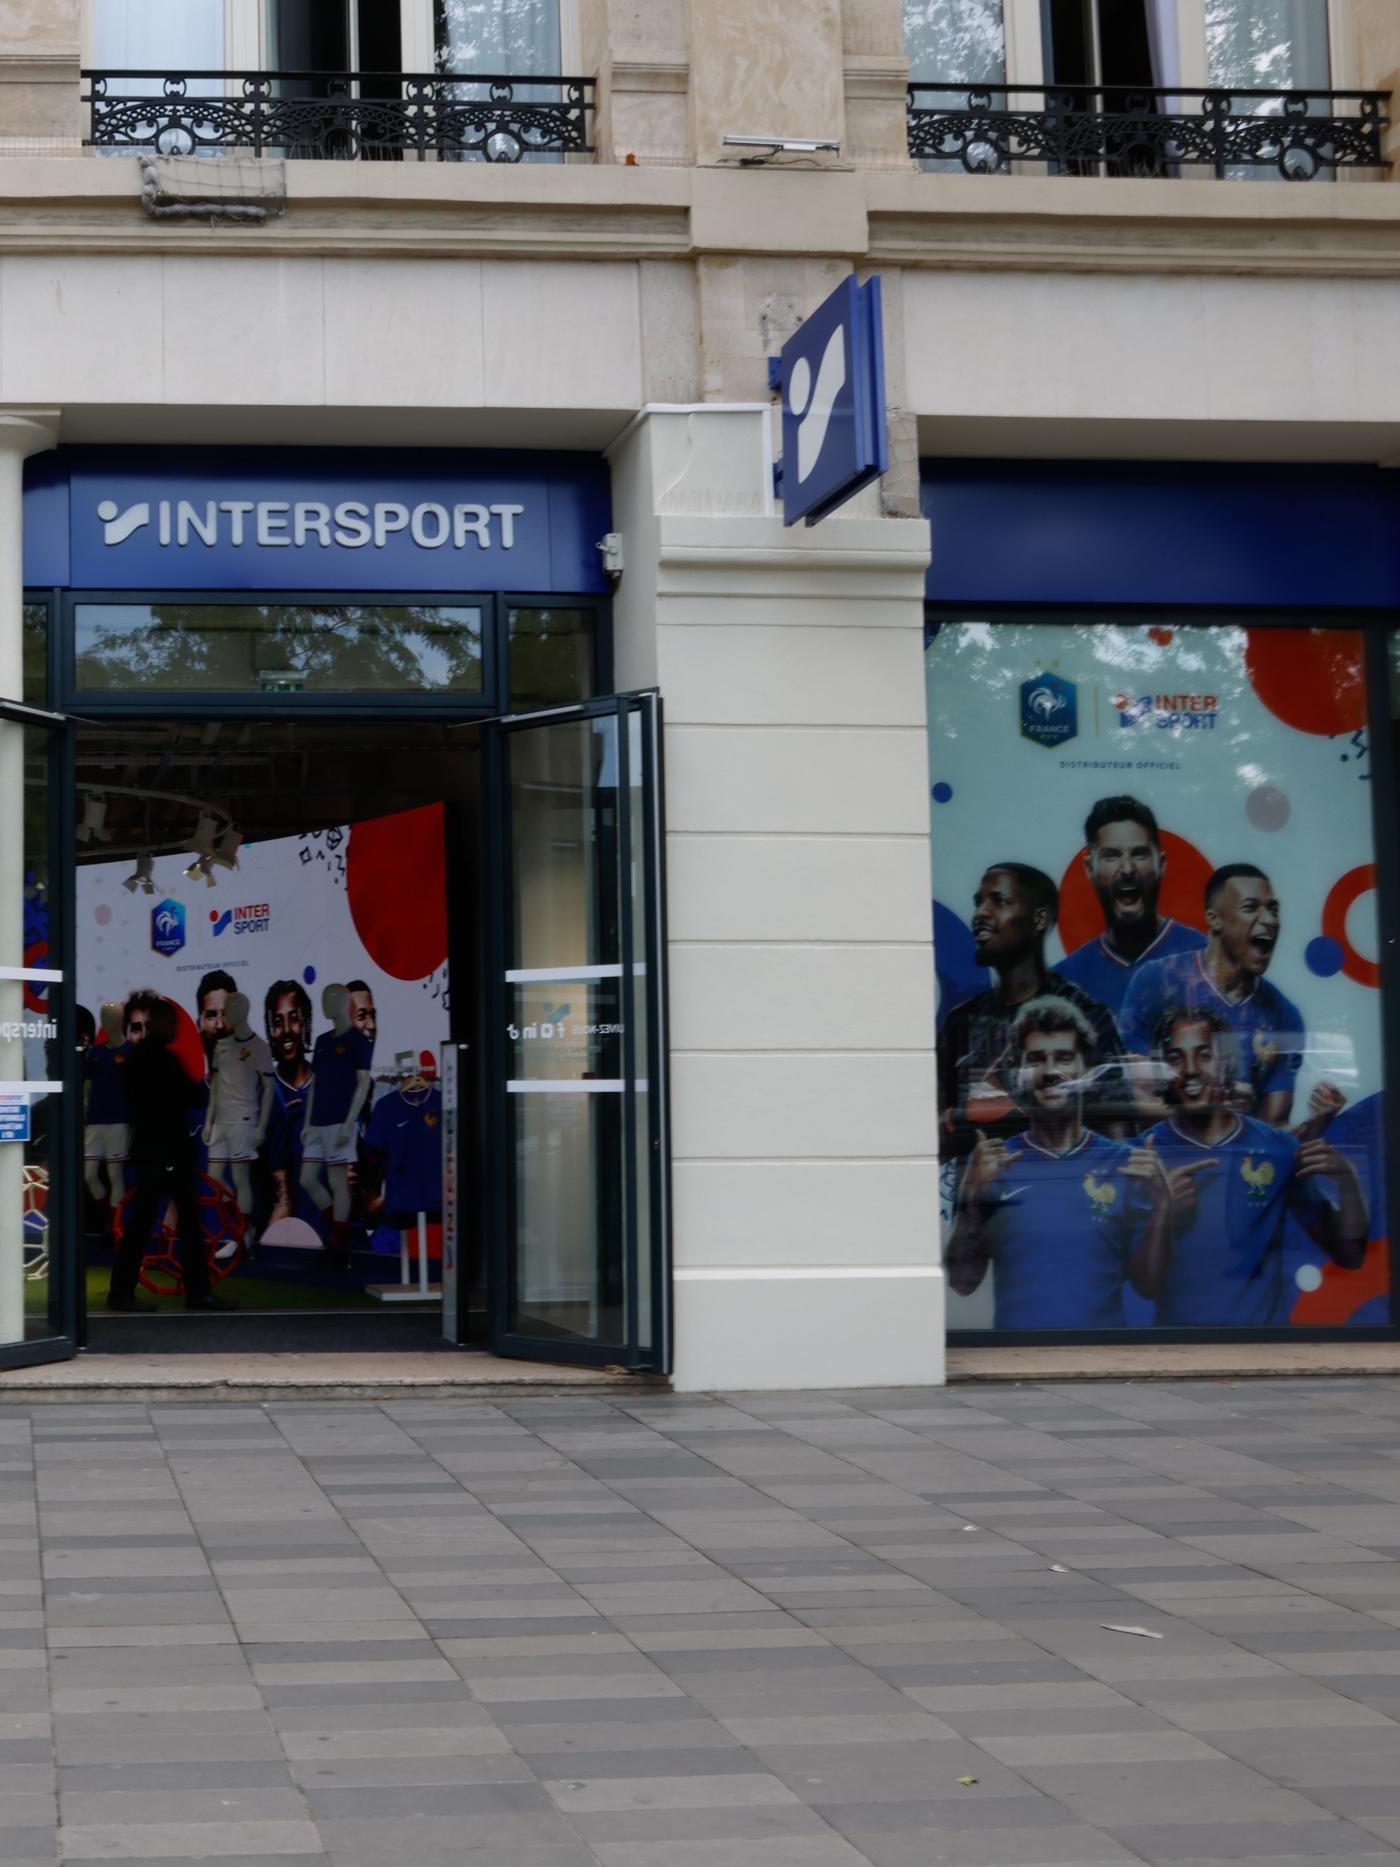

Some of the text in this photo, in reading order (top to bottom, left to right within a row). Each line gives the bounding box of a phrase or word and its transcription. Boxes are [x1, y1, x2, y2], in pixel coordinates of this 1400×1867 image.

[158, 500, 524, 549] INTERSPORT
[1155, 694, 1217, 712] INTER
[1028, 724, 1070, 734] FRANCE
[1155, 711, 1218, 730] SPORT
[1058, 761, 1182, 771] DISTRIBUTEUR OFFICIEL
[233, 903, 270, 921] INTER
[233, 918, 270, 935] SPORT
